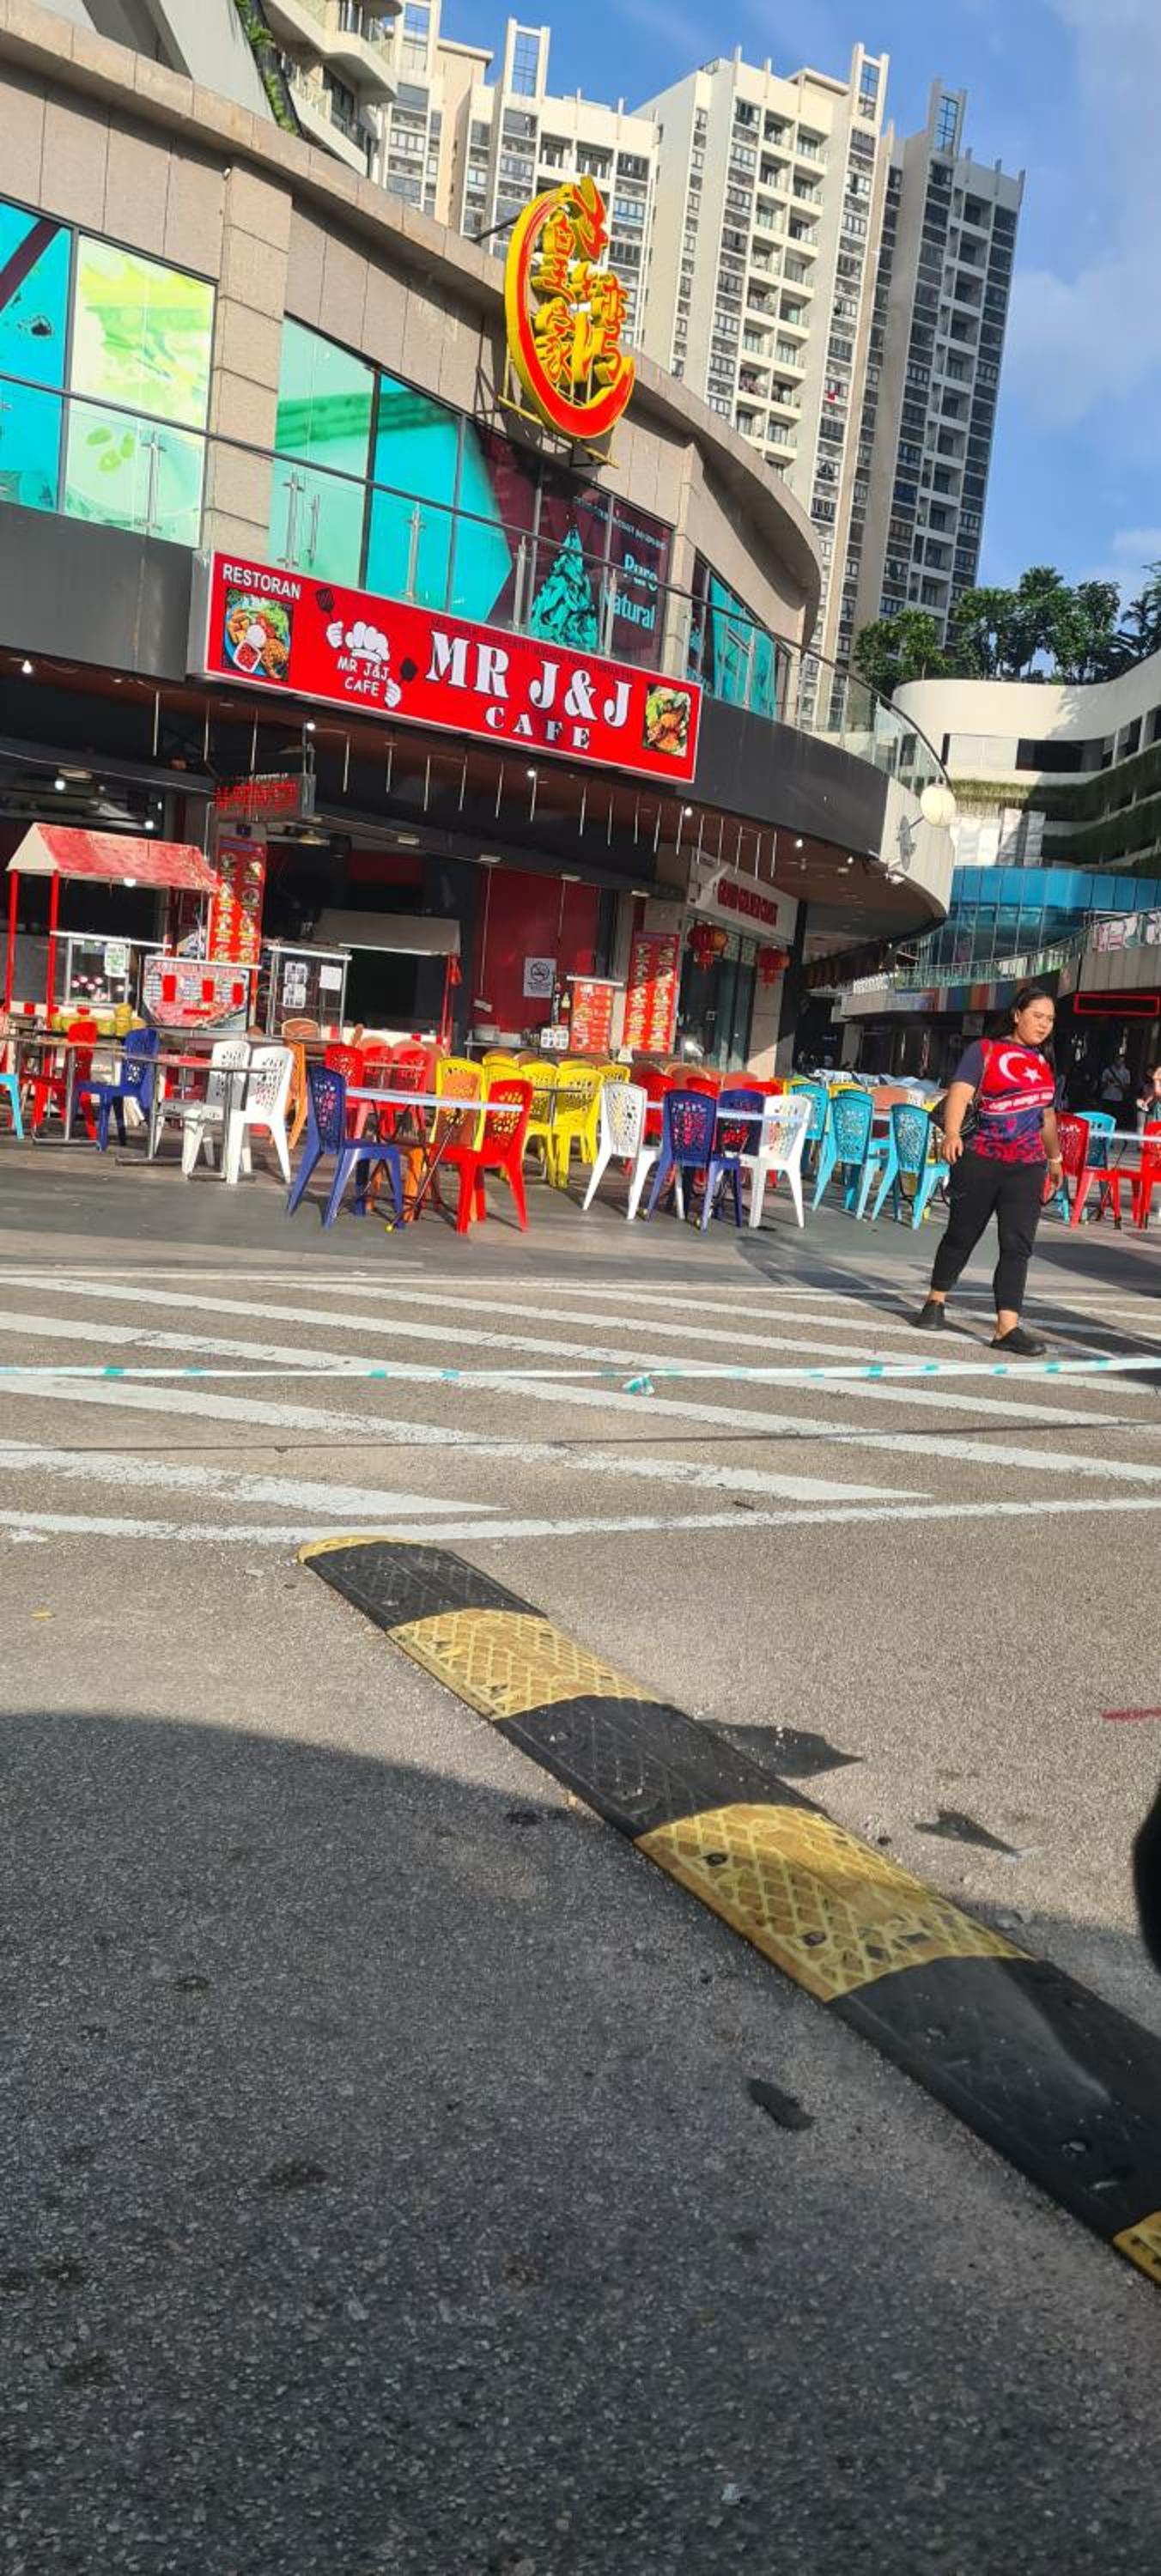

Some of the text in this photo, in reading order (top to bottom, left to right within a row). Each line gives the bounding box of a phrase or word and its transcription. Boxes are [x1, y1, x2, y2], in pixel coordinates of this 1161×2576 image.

[222, 563, 301, 599] RESTORAN
[337, 655, 391, 682] MR J&J
[344, 676, 380, 696] CAFE
[425, 631, 510, 698] MR
[529, 660, 634, 728] J&J
[484, 707, 591, 750] CAFE
